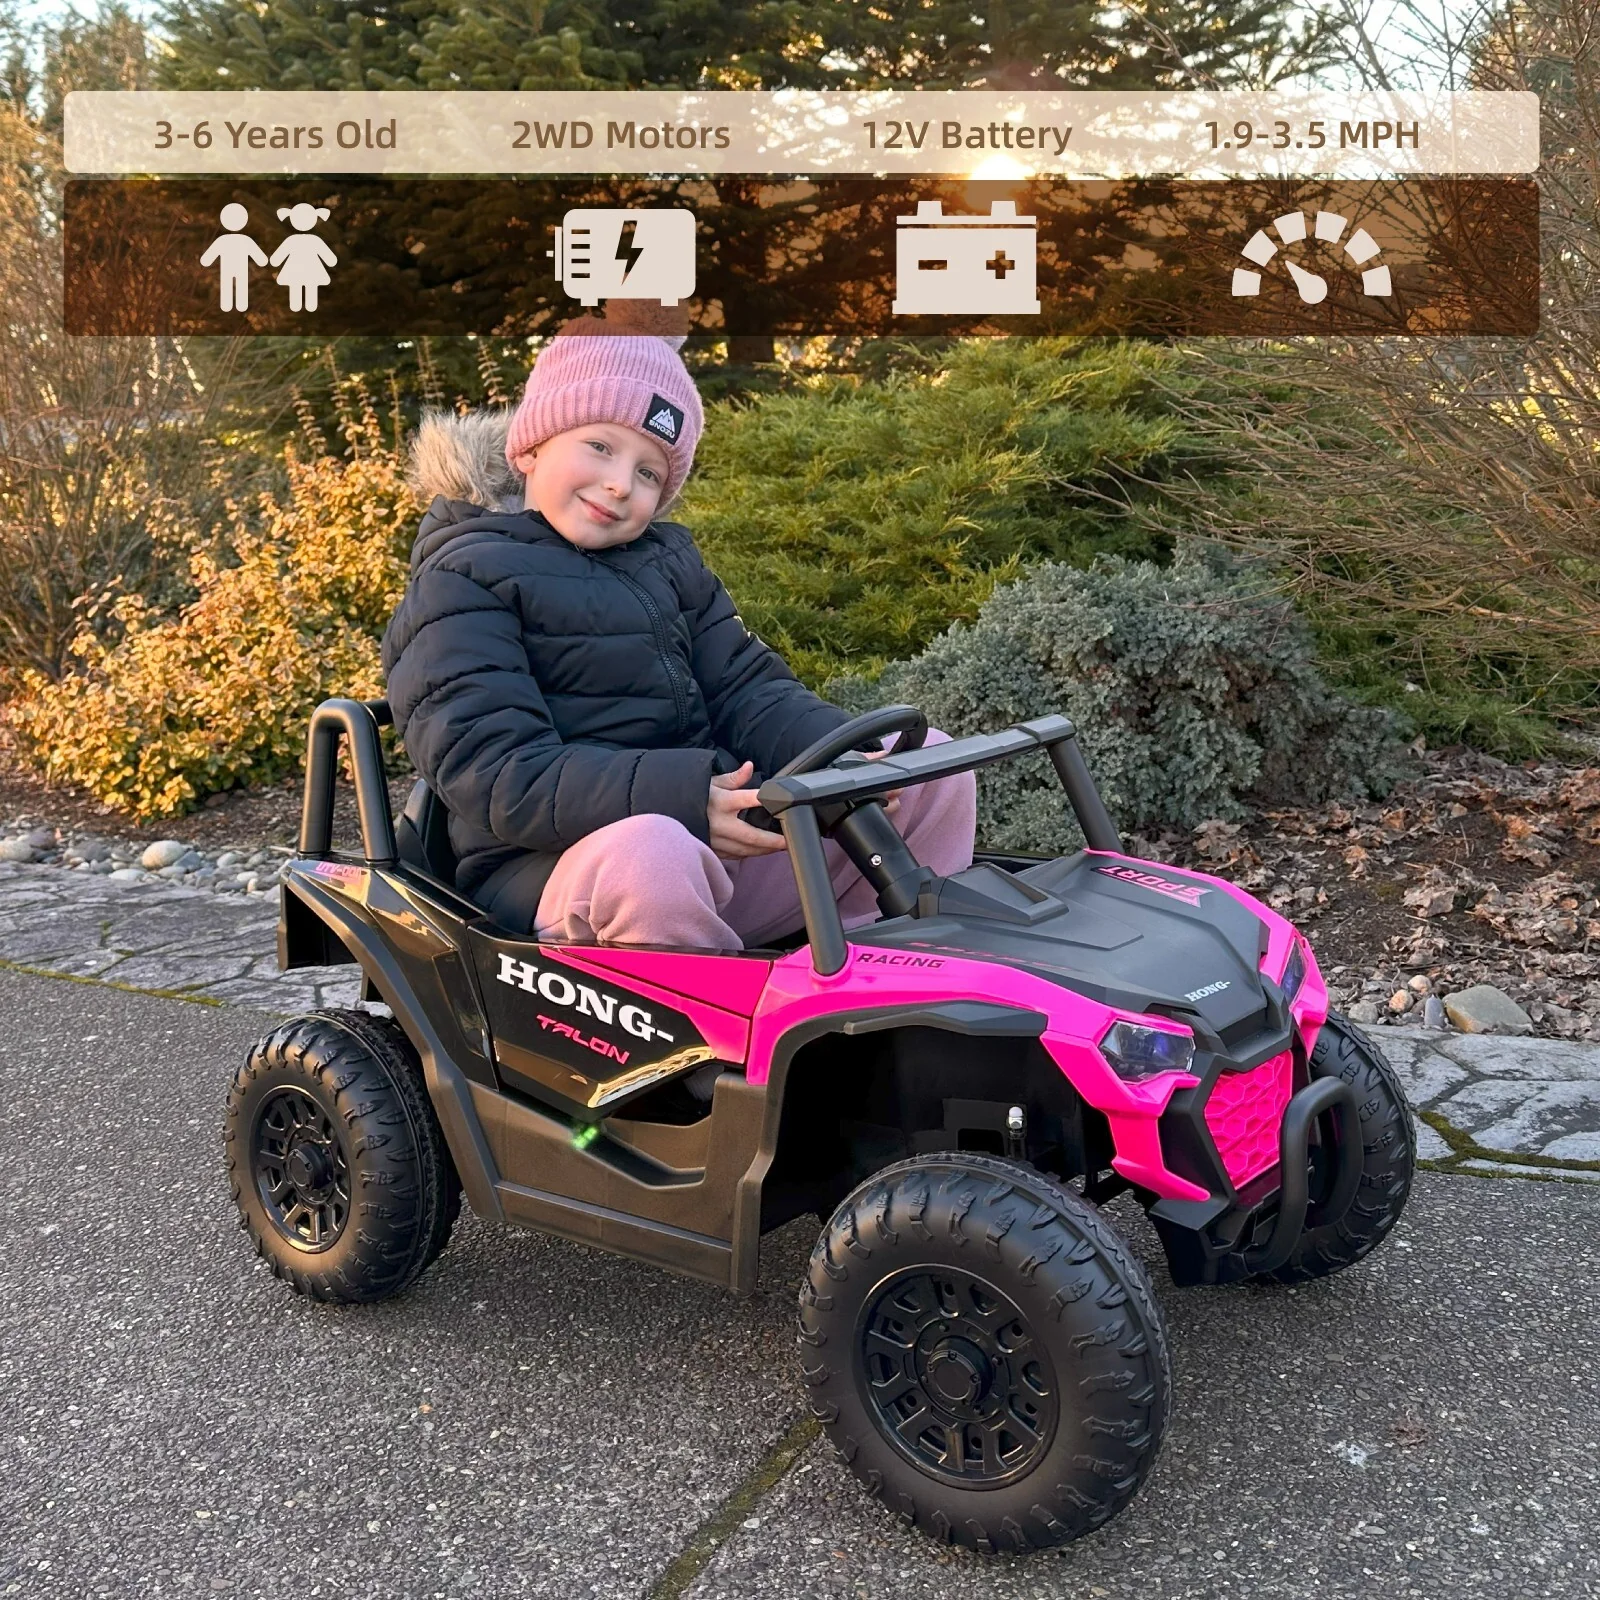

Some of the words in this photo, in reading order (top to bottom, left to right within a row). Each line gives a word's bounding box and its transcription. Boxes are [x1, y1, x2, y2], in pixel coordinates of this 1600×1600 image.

[1098, 866, 1204, 898] SPORT
[856, 953, 946, 969] RACING
[536, 1014, 630, 1065] TALON
